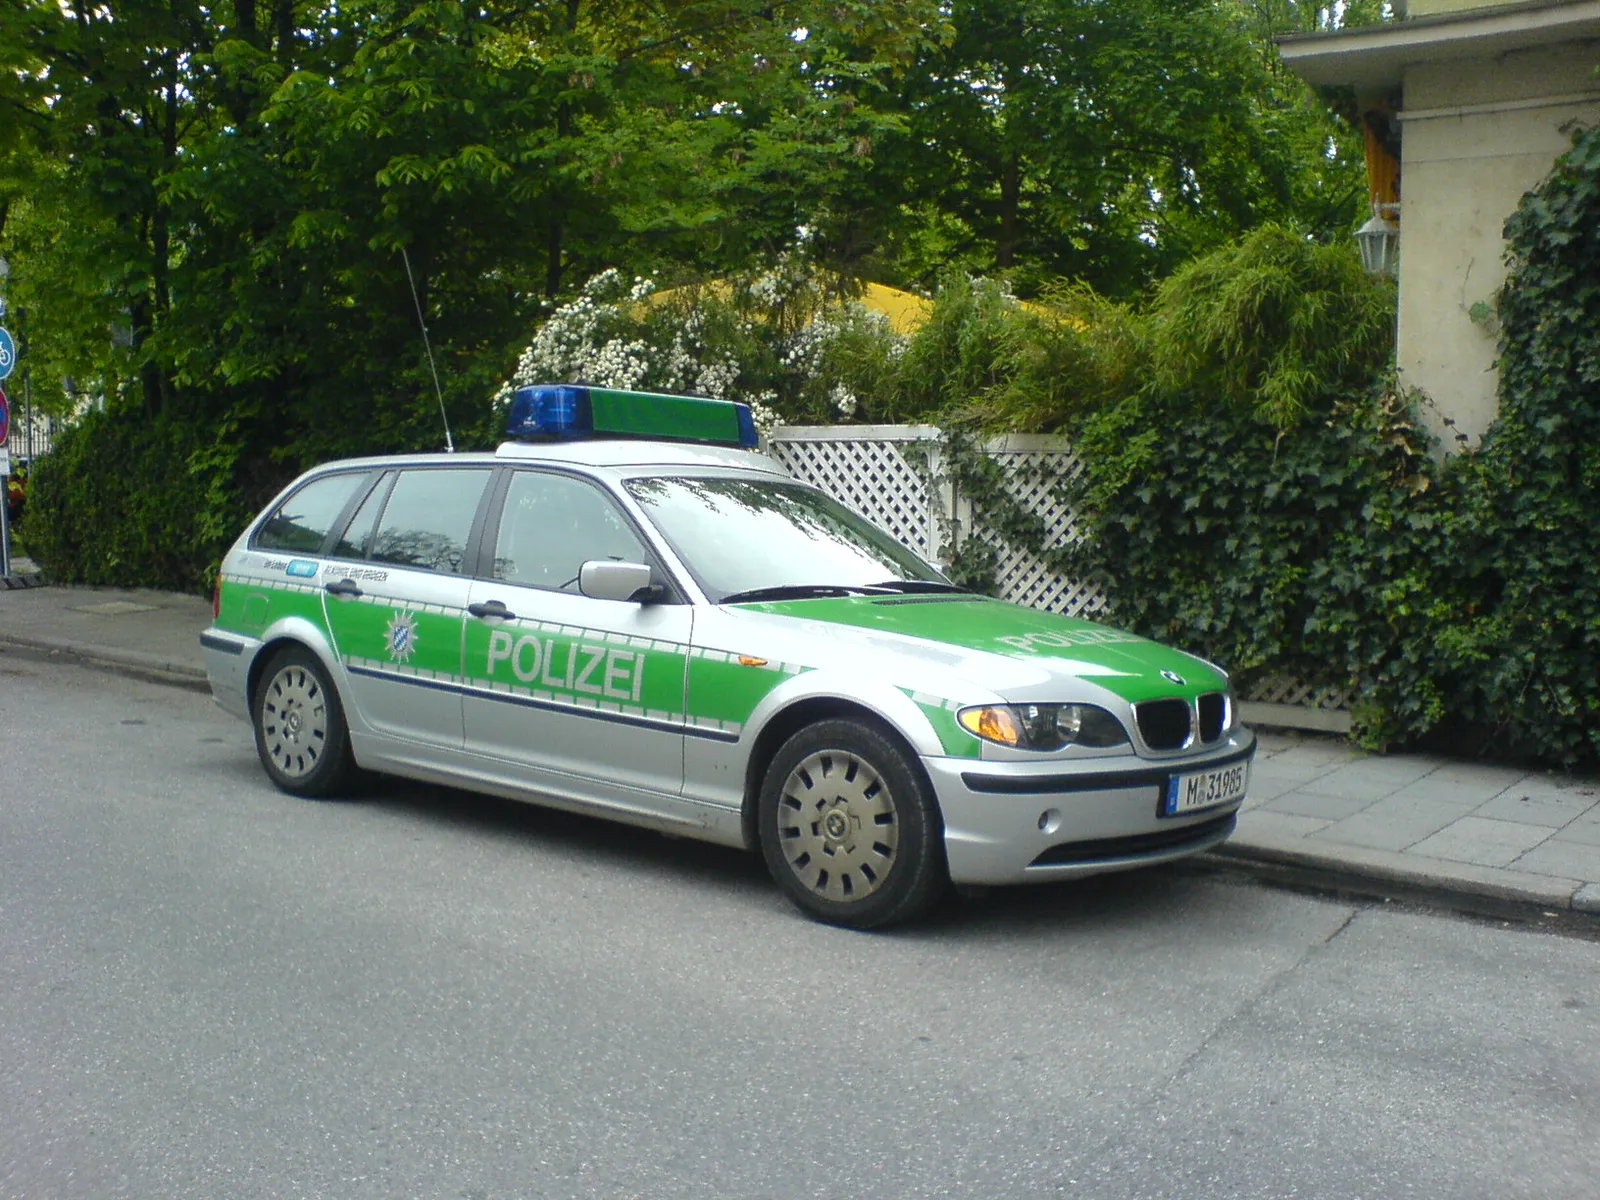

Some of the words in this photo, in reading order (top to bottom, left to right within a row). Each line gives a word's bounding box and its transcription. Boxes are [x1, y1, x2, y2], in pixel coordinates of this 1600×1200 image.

[487, 630, 645, 701] POLIZEI
[1186, 778, 1199, 805] M
[1206, 767, 1243, 801] 31985
